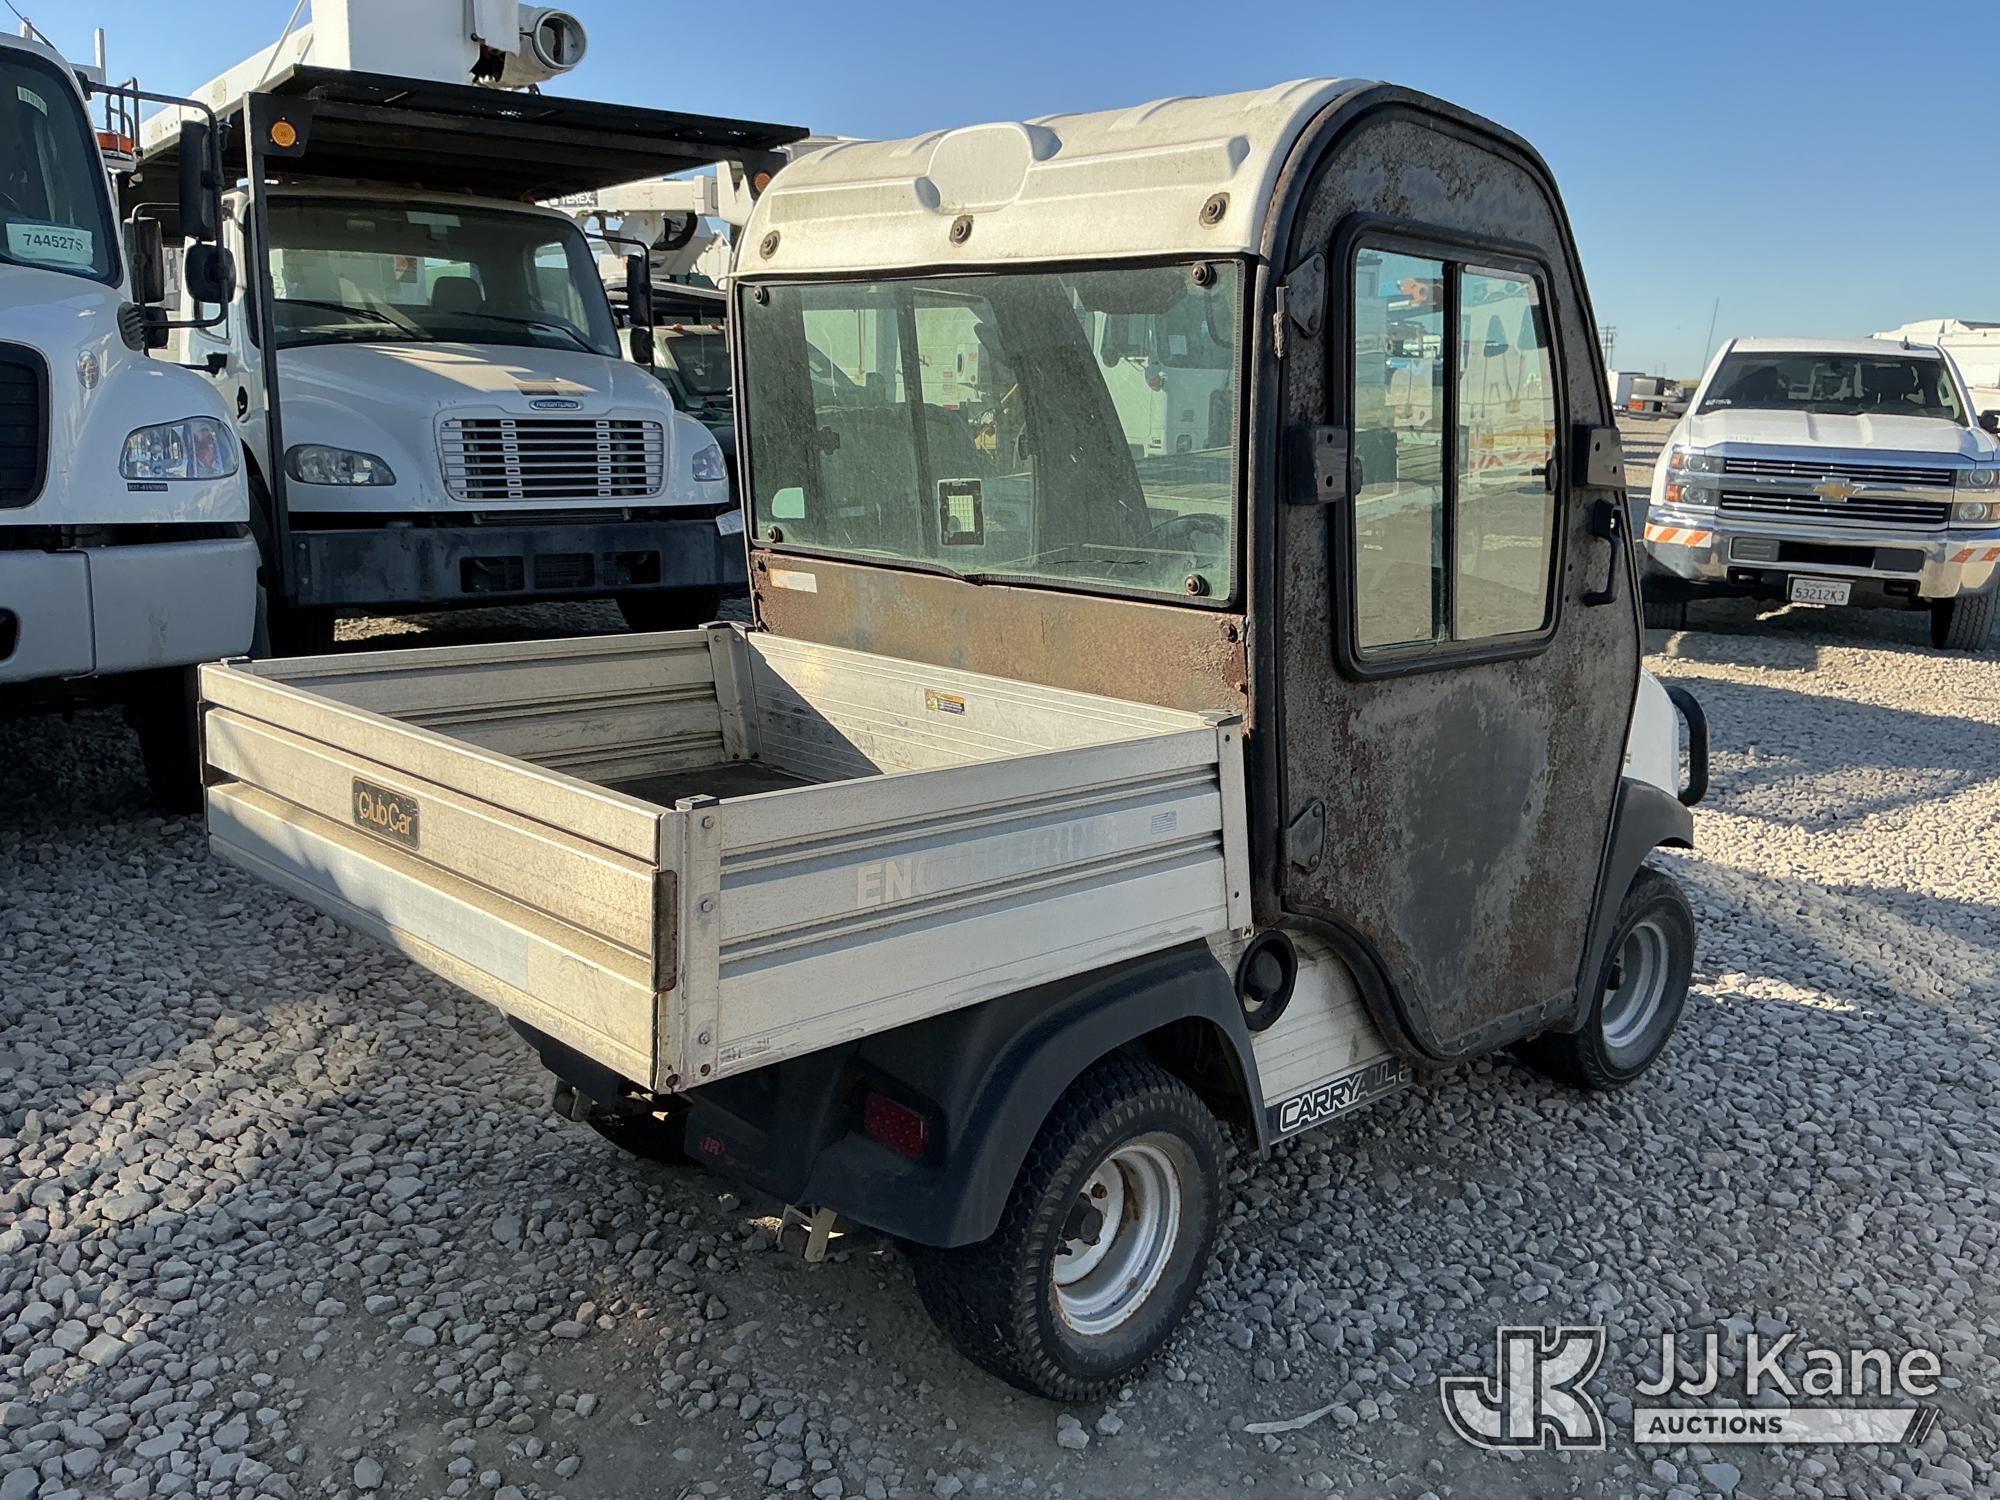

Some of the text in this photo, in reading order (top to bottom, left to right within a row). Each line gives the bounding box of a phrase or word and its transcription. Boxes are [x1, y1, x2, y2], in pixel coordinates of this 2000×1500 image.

[560, 191, 594, 205] TEREX
[1794, 587, 1846, 603] 53212K3
[358, 791, 412, 835] Club Car
